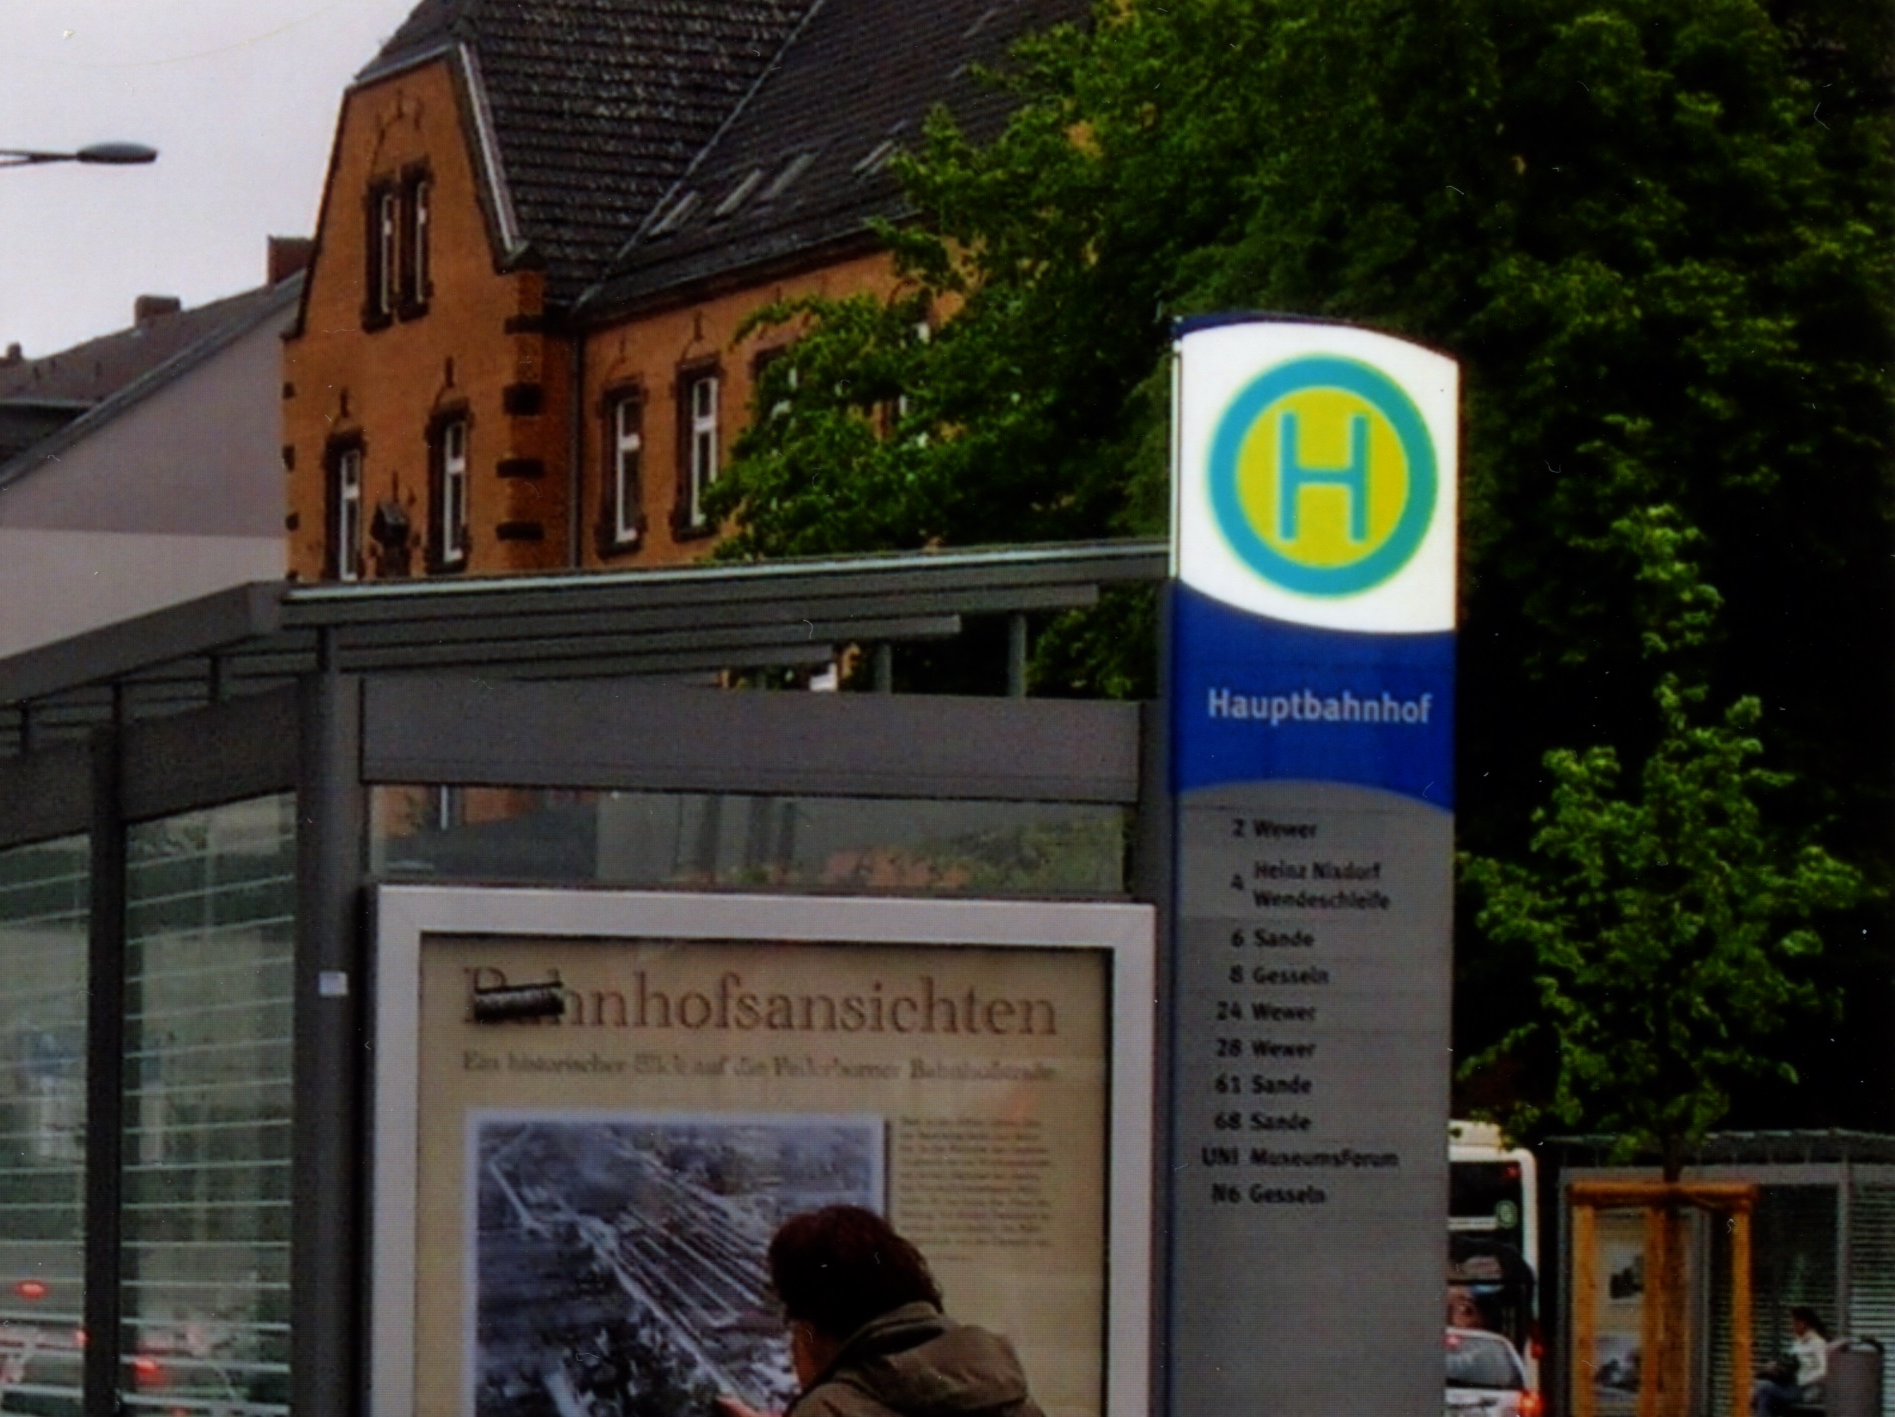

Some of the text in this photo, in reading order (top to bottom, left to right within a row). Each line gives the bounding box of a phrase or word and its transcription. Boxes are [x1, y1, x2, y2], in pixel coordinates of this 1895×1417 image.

[1279, 410, 1371, 544] H
[1207, 686, 1434, 726] Hauptbahnhof
[1231, 819, 1317, 838] 2 Wewer
[1252, 860, 1306, 880] Heinz
[1252, 890, 1390, 910] Wendeschleife
[1230, 928, 1315, 948] 6 Sande
[1229, 965, 1330, 985] 8 Gesseln
[1216, 1001, 1316, 1022] 24 Wewer
[1215, 1038, 1316, 1058] 28 Wewer
[1215, 1074, 1313, 1094] 61 Sande
[1213, 1111, 1312, 1131] 68 Sande
[1201, 1146, 1240, 1167] UNI
[1211, 1183, 1327, 1204] N6 Gesseln
